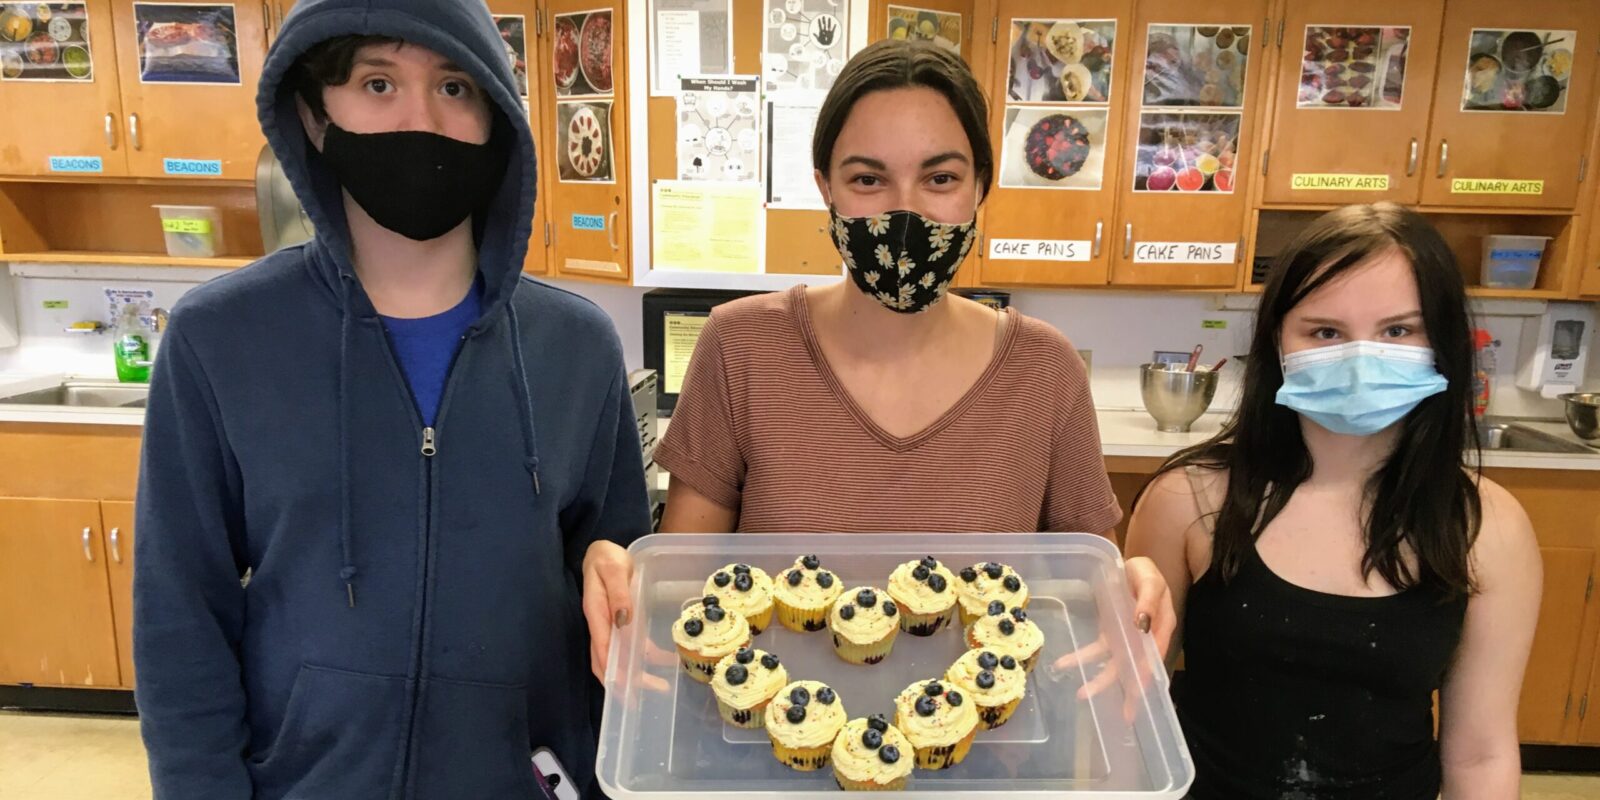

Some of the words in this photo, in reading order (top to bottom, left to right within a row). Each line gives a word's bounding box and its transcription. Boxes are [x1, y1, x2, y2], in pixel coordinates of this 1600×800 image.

[52, 158, 100, 170] BEACONS
[167, 161, 219, 172] BEACONS
[1294, 176, 1352, 187] CULINARY
[1355, 178, 1387, 188] ARTS
[1453, 181, 1508, 191] CULINARY
[1511, 182, 1541, 192] ARTS
[574, 216, 603, 228] BEACONS
[994, 242, 1029, 255] CAKE
[1037, 242, 1076, 258] PANS
[1137, 245, 1178, 259] CAKE
[1187, 245, 1222, 259] PANS
